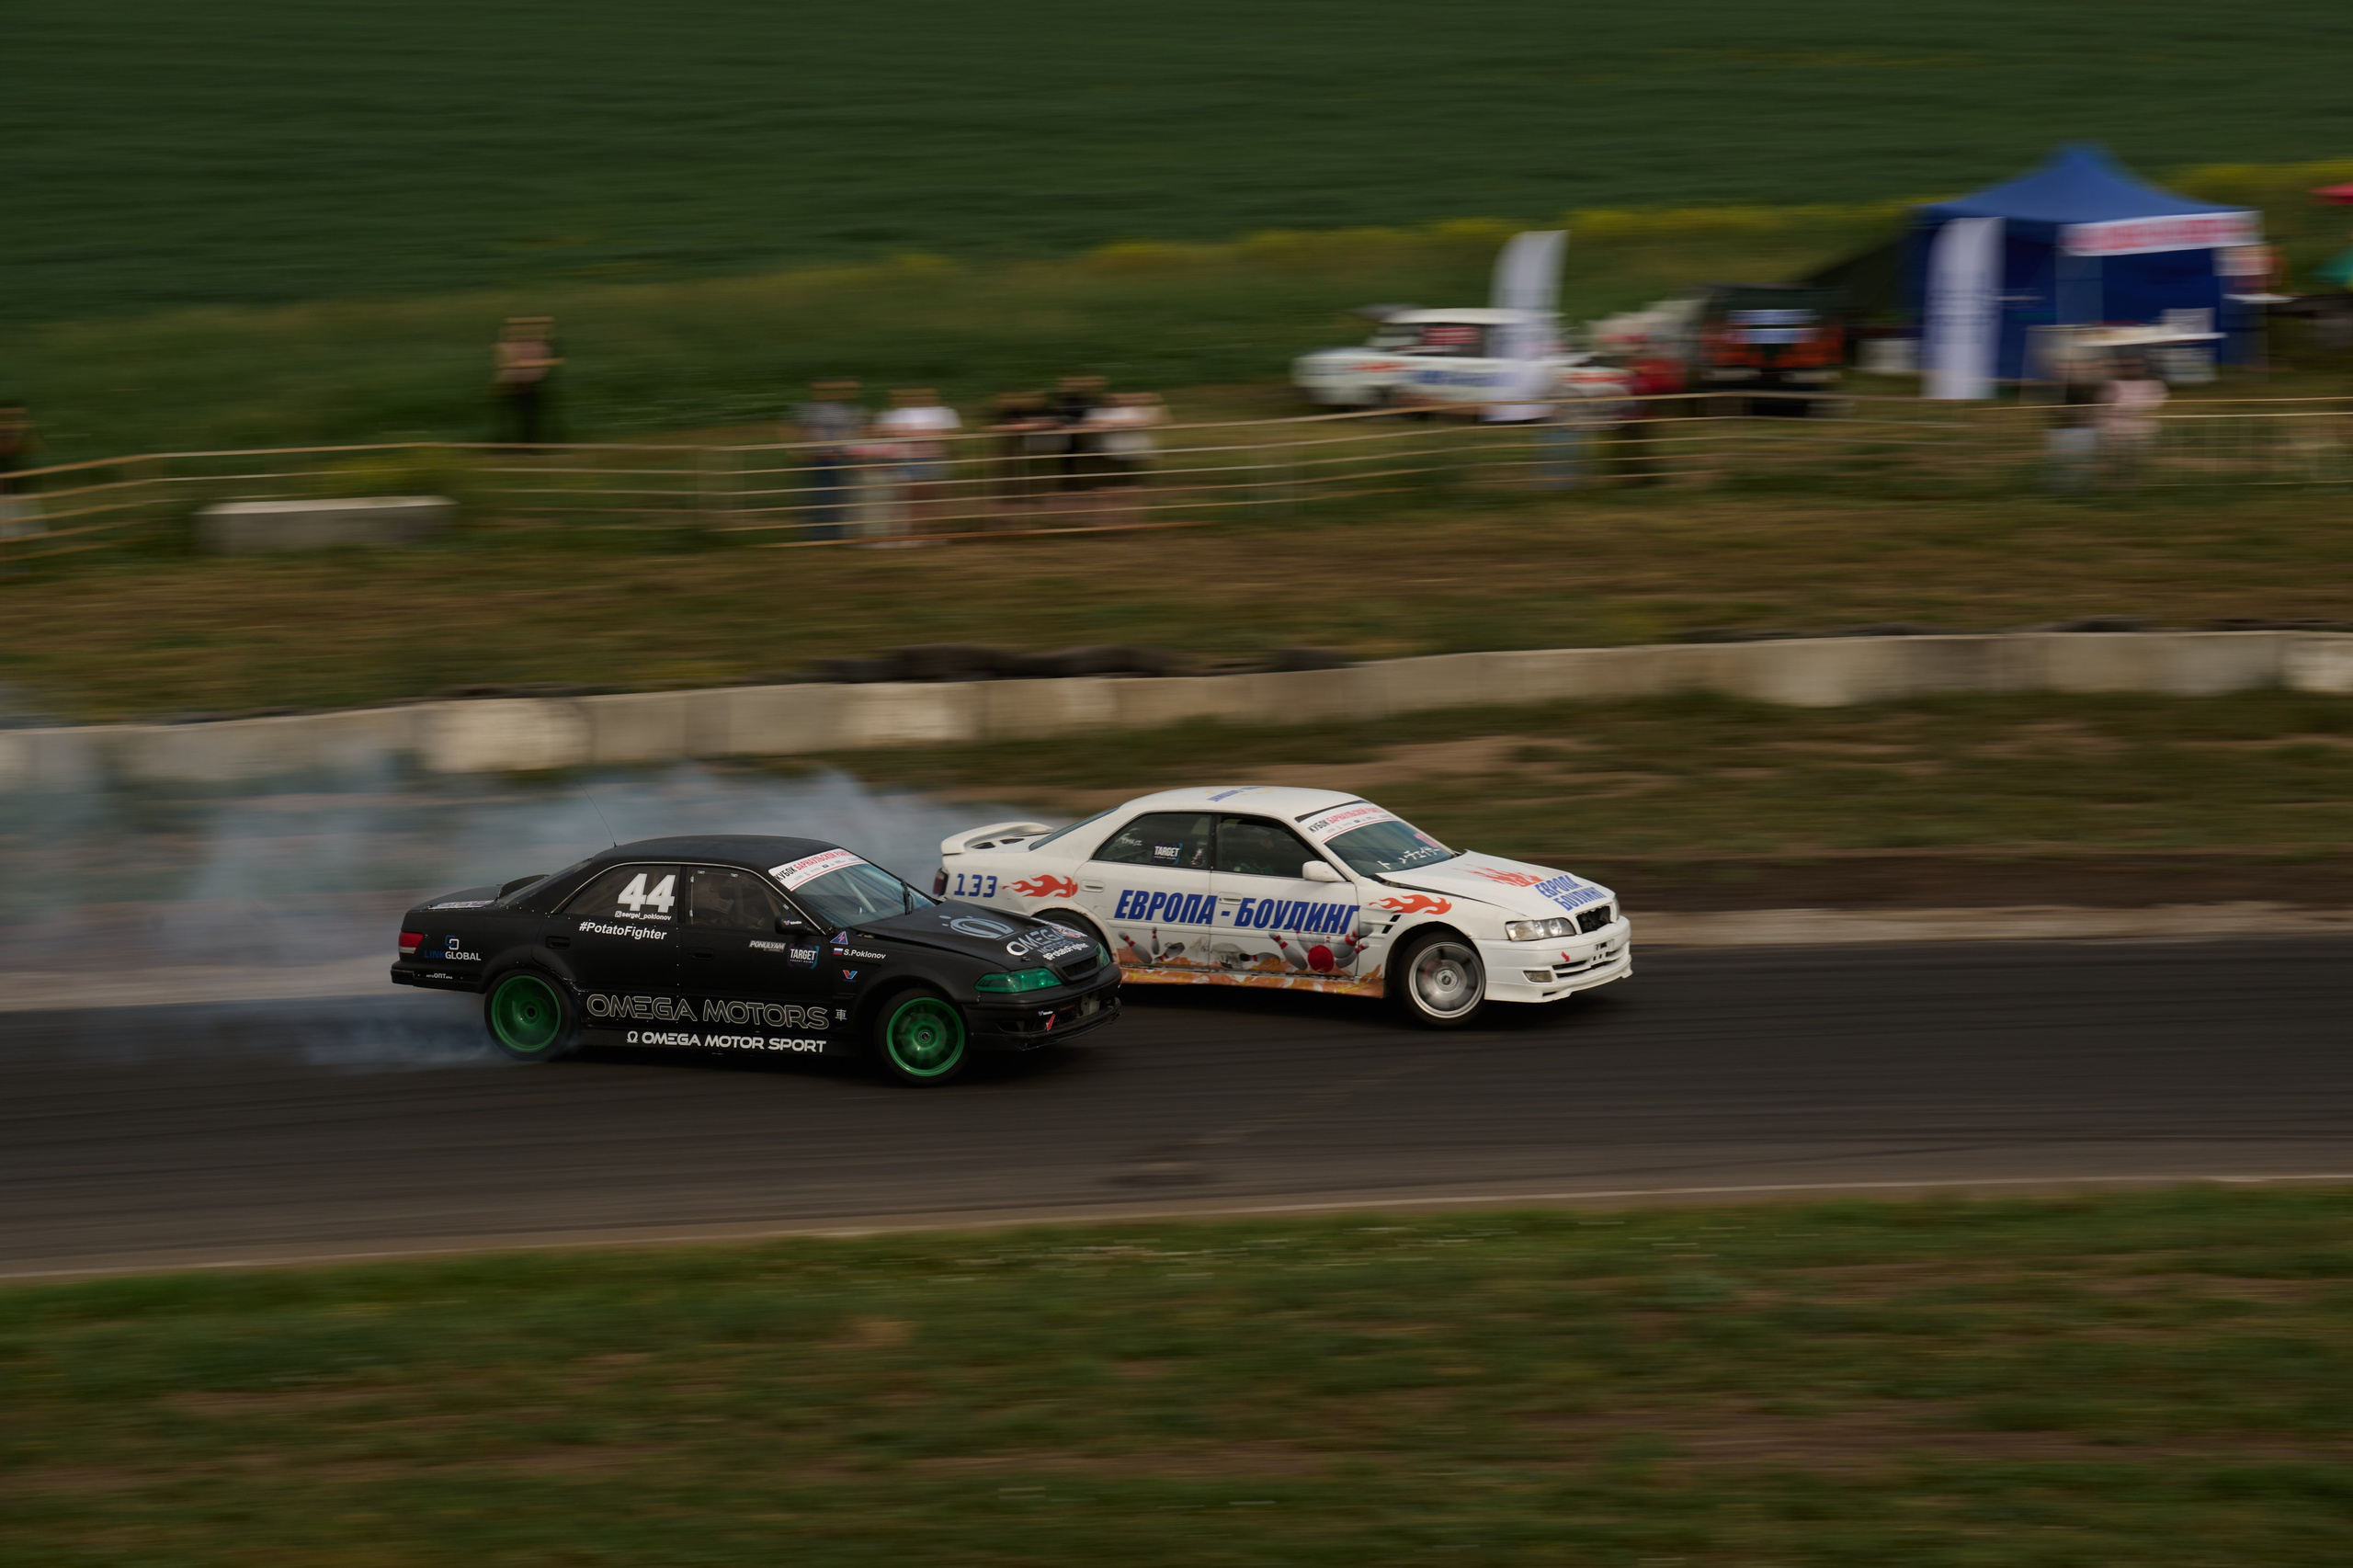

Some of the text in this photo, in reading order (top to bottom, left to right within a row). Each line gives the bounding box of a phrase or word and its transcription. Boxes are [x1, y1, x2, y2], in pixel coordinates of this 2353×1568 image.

[1154, 846, 1181, 857] TARGET
[617, 872, 676, 913] 44
[953, 873, 997, 898] 133
[1534, 874, 1583, 898] ЕВРОПА
[1553, 886, 1607, 911] БОУЛИНГ
[1114, 889, 1218, 925] ЕВРОПА
[1233, 897, 1360, 934] БОУЛИНГ
[578, 921, 667, 940] #PotatoFighter
[1006, 928, 1064, 956] OMEGA
[790, 949, 817, 960] TARGET
[843, 949, 887, 960] S.Poklonov
[586, 994, 830, 1030] OMEGA MOTORS
[641, 1031, 701, 1047] OMEGA
[704, 1034, 765, 1051] MOTOR
[767, 1038, 827, 1053] SPORT
